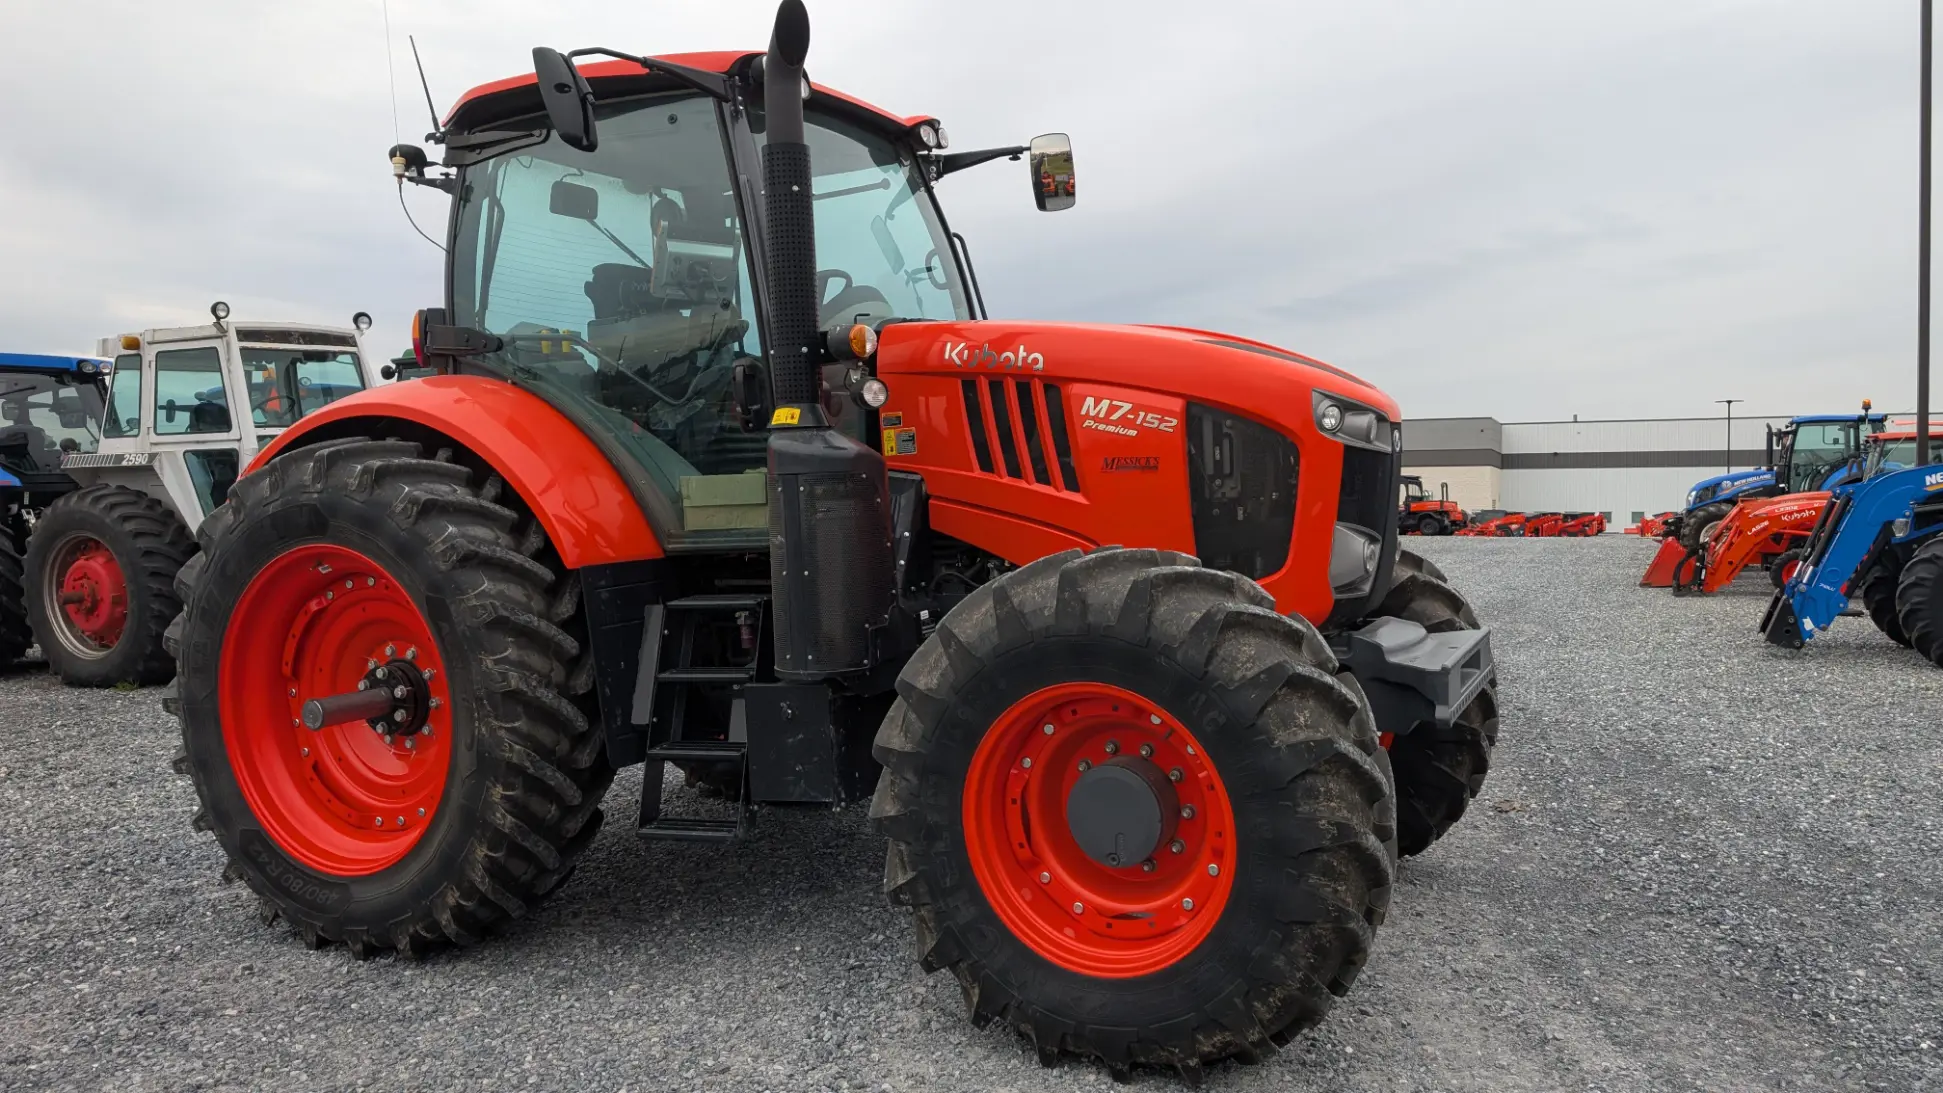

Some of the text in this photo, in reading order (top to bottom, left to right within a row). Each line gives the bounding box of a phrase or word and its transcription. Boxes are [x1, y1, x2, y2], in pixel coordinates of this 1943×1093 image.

[944, 342, 1044, 372] Kubota
[1080, 396, 1178, 433] M7-152
[1082, 419, 1138, 437] Premium
[120, 453, 149, 465] 2590
[1746, 474, 1771, 482] HOLLAND
[1781, 509, 1816, 521] Kubota
[280, 873, 340, 905] 480/80
